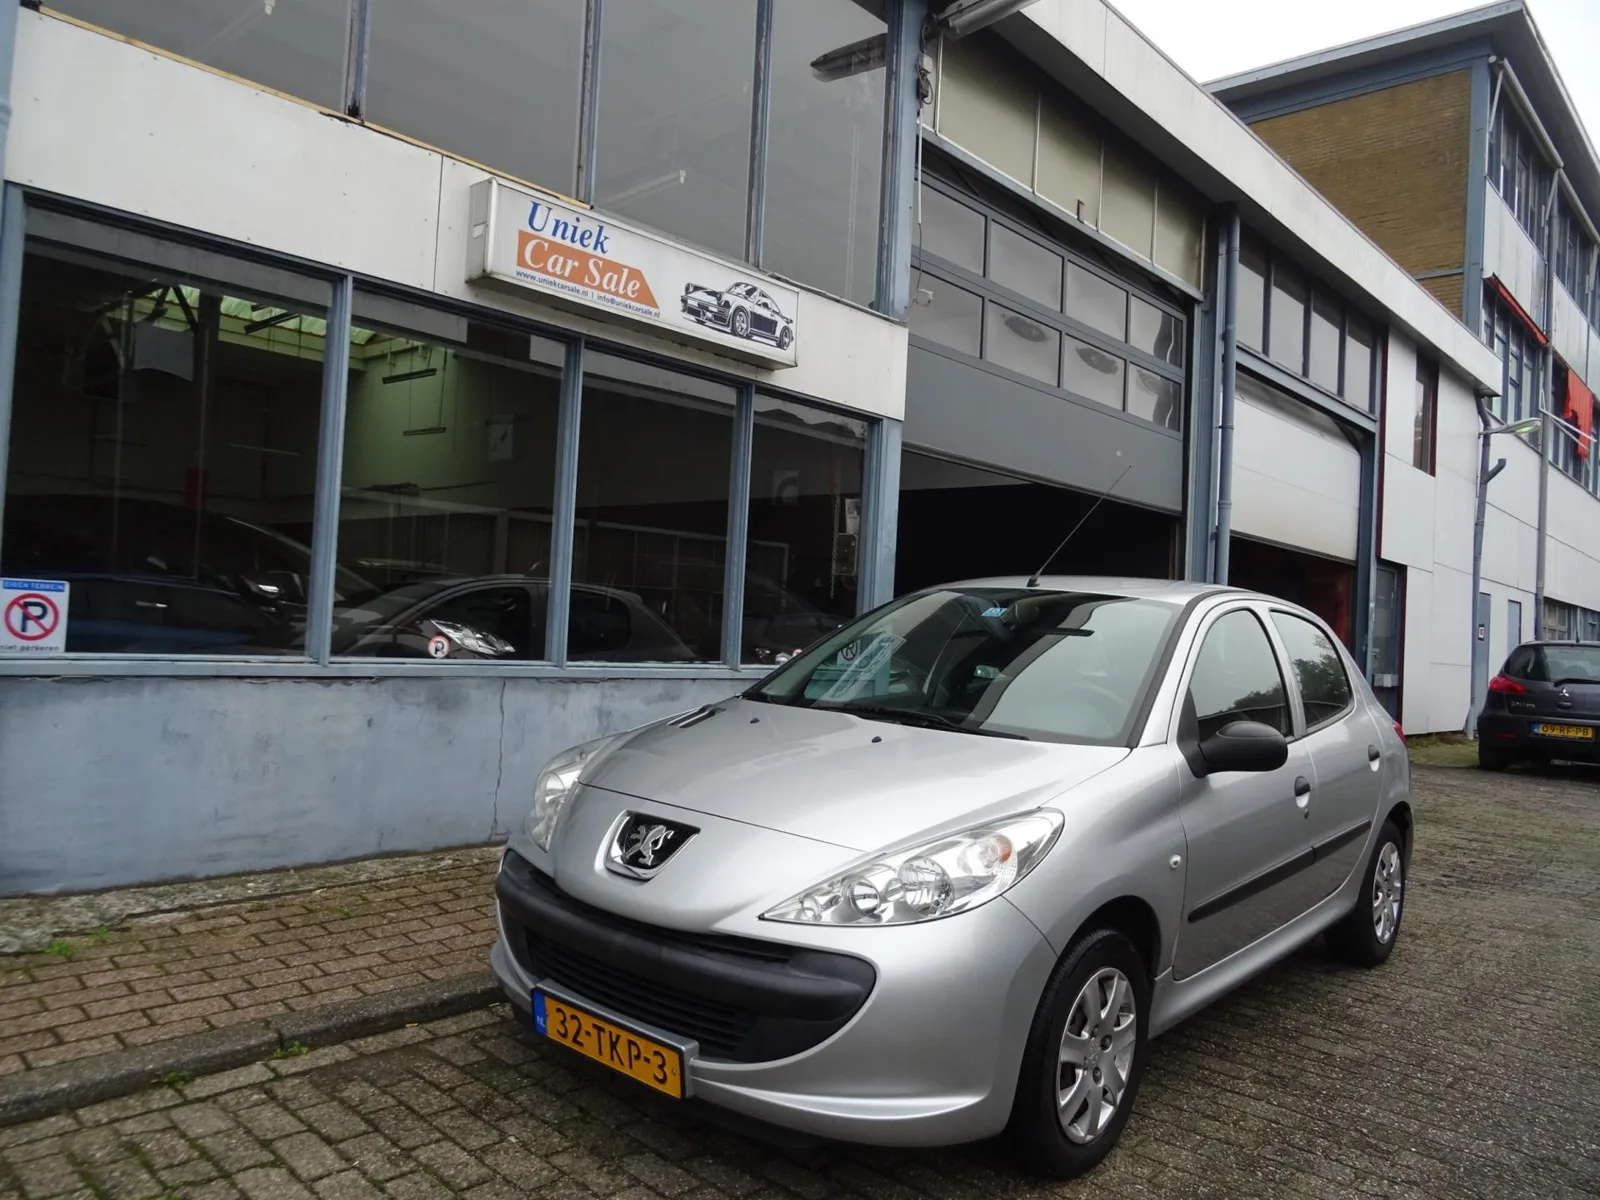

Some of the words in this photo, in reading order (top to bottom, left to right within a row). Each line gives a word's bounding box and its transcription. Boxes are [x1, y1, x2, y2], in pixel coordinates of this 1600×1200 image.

[528, 200, 610, 254] Uniek
[515, 269, 589, 297] www.uniekcarsale.nl
[596, 294, 660, 319] info@uniekcarsale.nl
[524, 239, 579, 278] Car
[584, 258, 640, 298] Sale
[1541, 724, 1589, 737] 09-RF-PB
[536, 1015, 546, 1028] NL
[555, 1007, 668, 1084] 32-TKP-3
